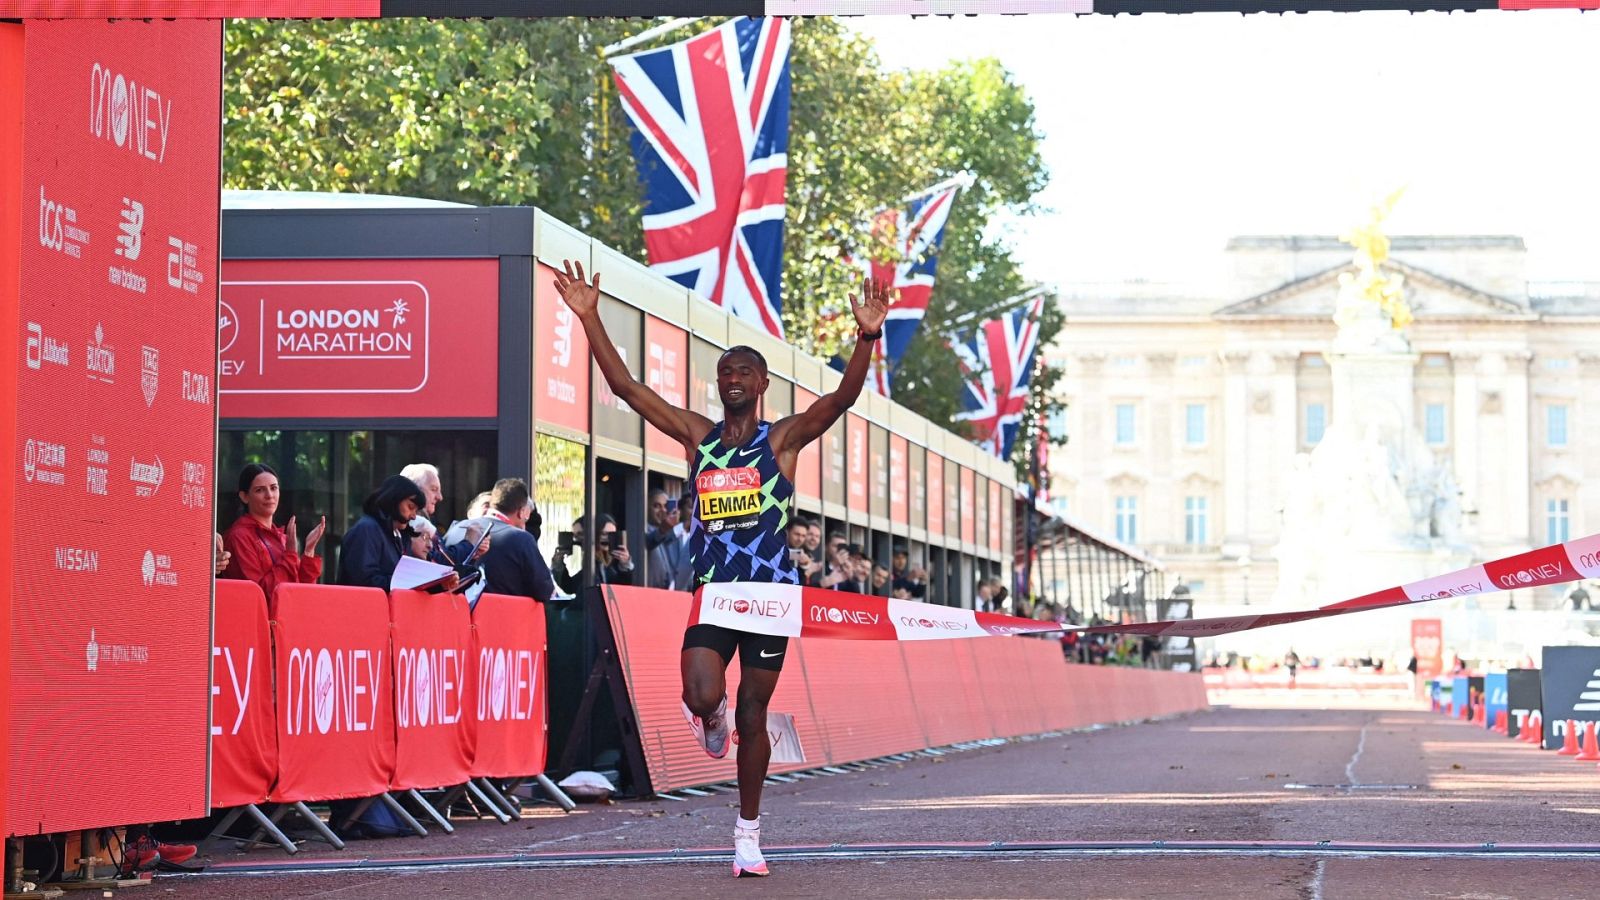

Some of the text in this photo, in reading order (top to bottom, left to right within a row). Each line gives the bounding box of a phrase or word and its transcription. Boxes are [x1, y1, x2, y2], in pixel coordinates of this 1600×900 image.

[90, 62, 171, 163] MONEY
[277, 309, 379, 328] LONDON
[277, 332, 412, 352] MARATHON
[87, 345, 115, 375] BUXTON
[182, 369, 210, 405] FLORA
[86, 466, 108, 496] PRIDE
[699, 472, 757, 489] MONEY
[702, 494, 757, 516] LEMMA
[55, 547, 98, 572] NISSAN
[1500, 561, 1563, 587] MONEY
[712, 596, 791, 618] MONEY
[810, 605, 879, 625] MONEY
[901, 617, 968, 631] MONEY
[287, 647, 382, 735] MONEY
[397, 647, 465, 729] MONEY
[477, 647, 540, 722] MONEY
